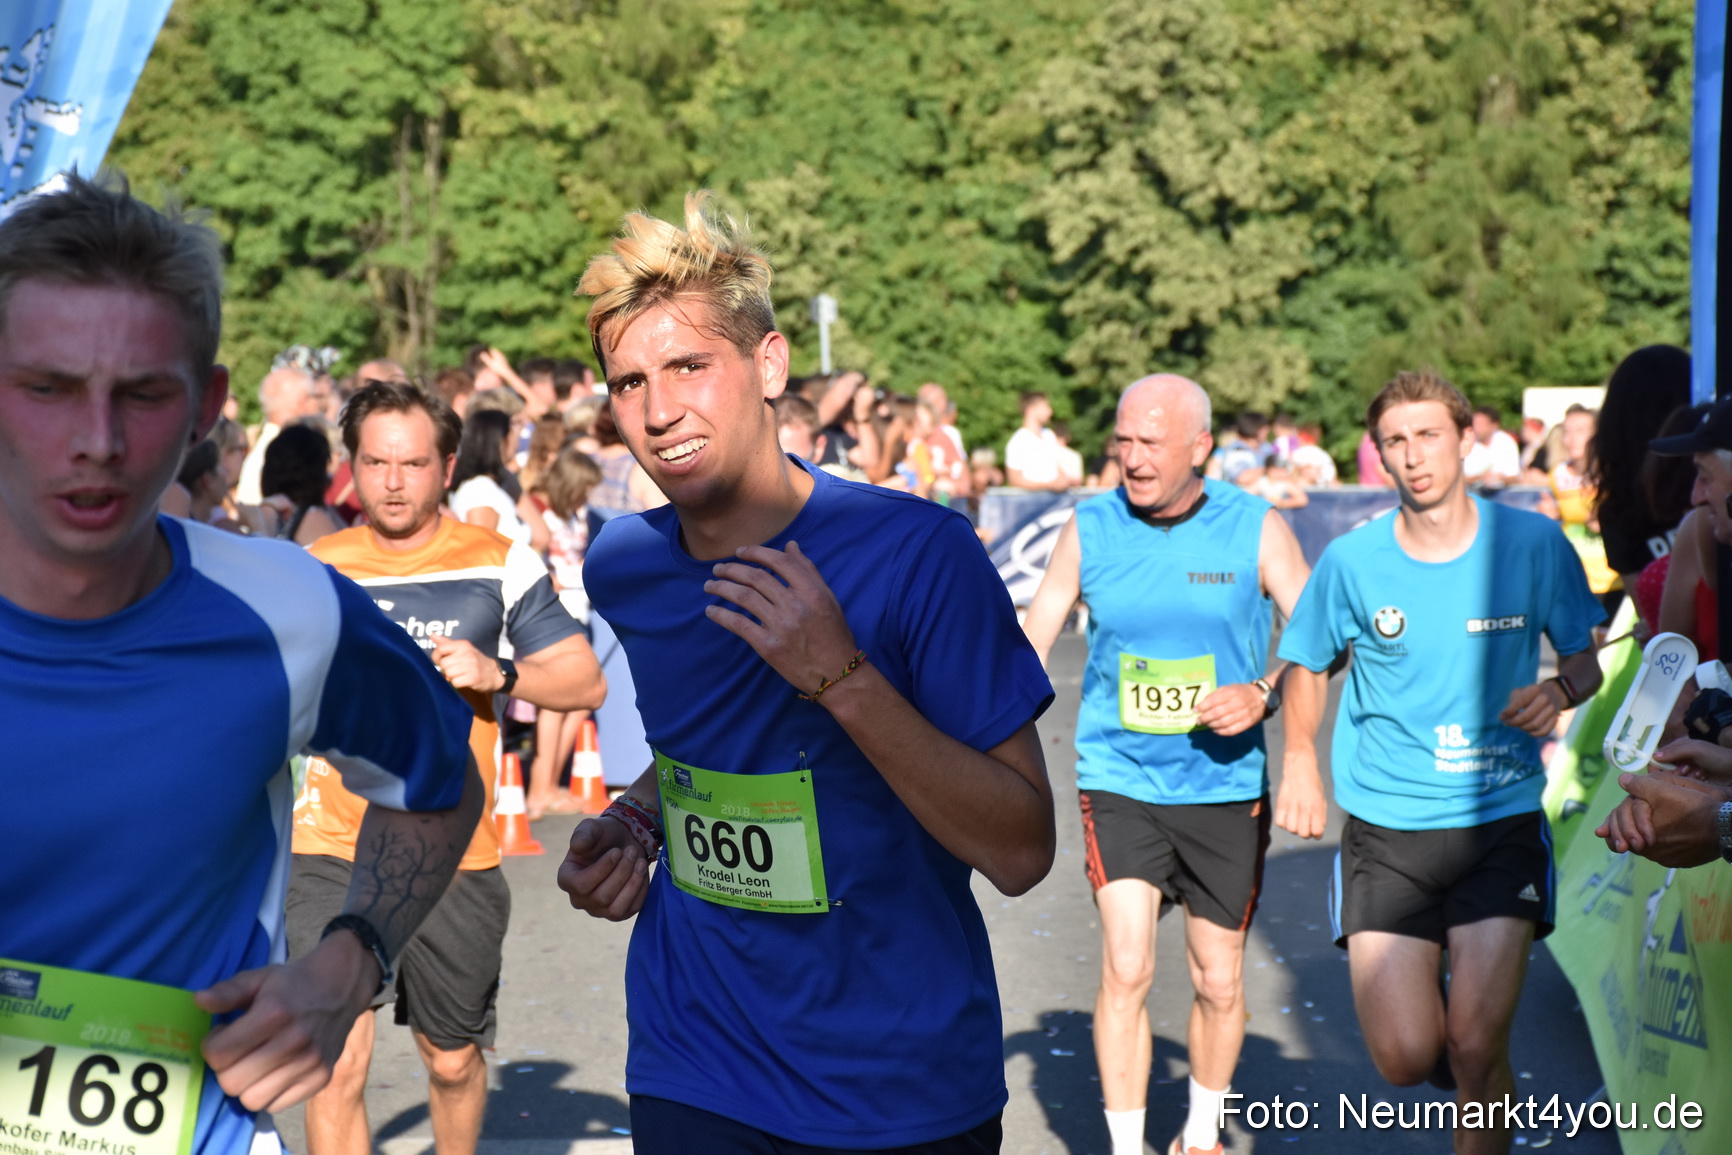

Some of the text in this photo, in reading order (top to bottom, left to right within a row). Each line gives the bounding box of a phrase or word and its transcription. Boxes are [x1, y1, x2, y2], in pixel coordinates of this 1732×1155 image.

[1187, 572, 1236, 584] THULE
[396, 616, 460, 637] her
[1466, 615, 1526, 633] BOCK
[1131, 684, 1201, 712] 1937
[1434, 724, 1470, 747] 18.
[669, 779, 713, 802] firmenlauf
[721, 804, 750, 818] 2018
[684, 813, 774, 873] 660
[697, 864, 771, 888] Krodel Leon
[698, 878, 715, 890] Fritz
[716, 883, 743, 896] Berger
[745, 888, 773, 899] GmbH
[18, 1044, 168, 1135] 168
[58, 1130, 137, 1155] Markus
